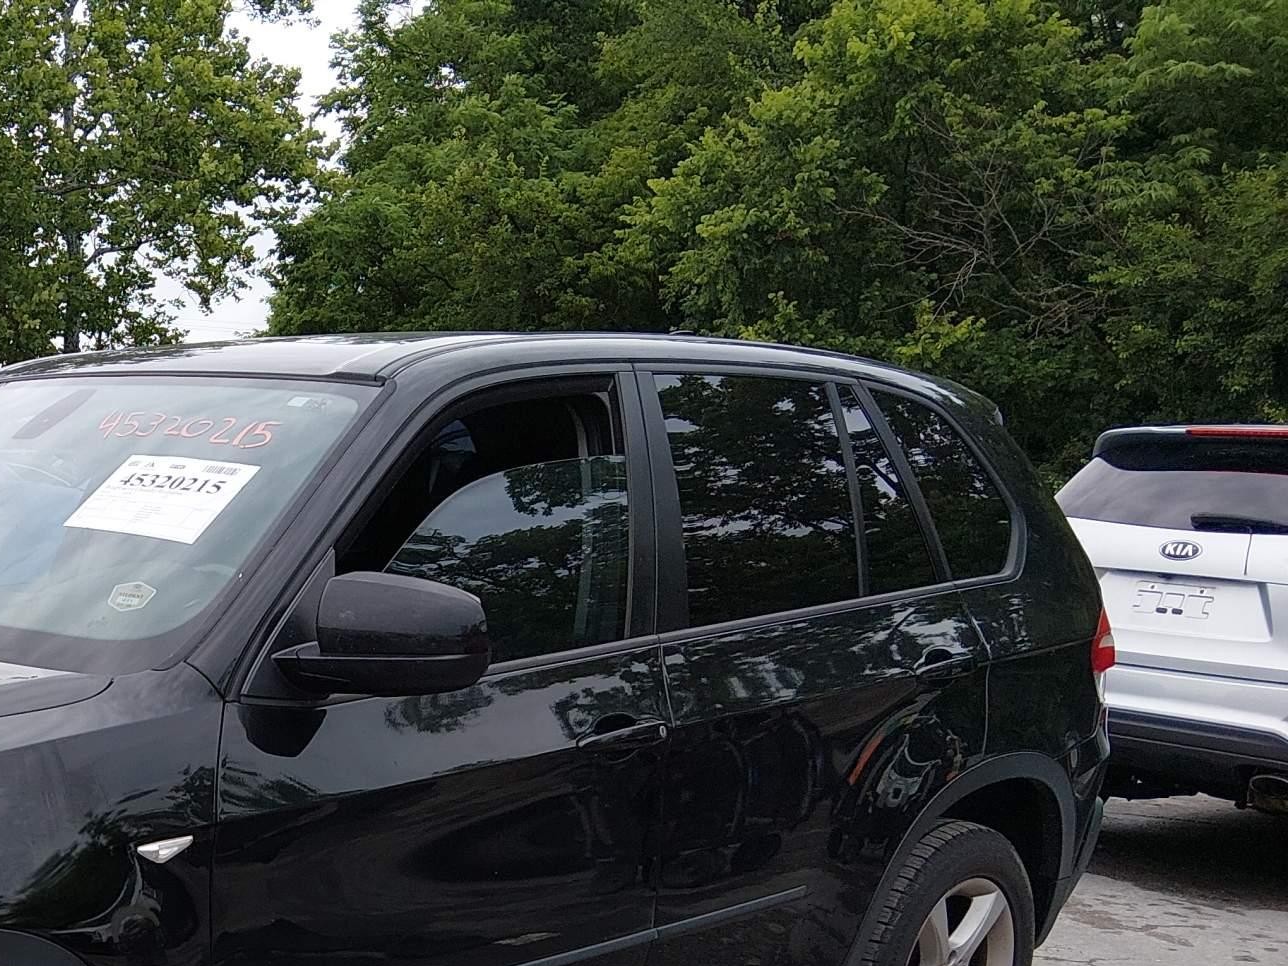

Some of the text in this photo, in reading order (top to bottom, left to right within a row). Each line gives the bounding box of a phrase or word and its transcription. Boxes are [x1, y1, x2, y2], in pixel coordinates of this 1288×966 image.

[98, 410, 284, 449] 45320215
[119, 472, 228, 494] 45320215
[1164, 543, 1193, 556] KIA
